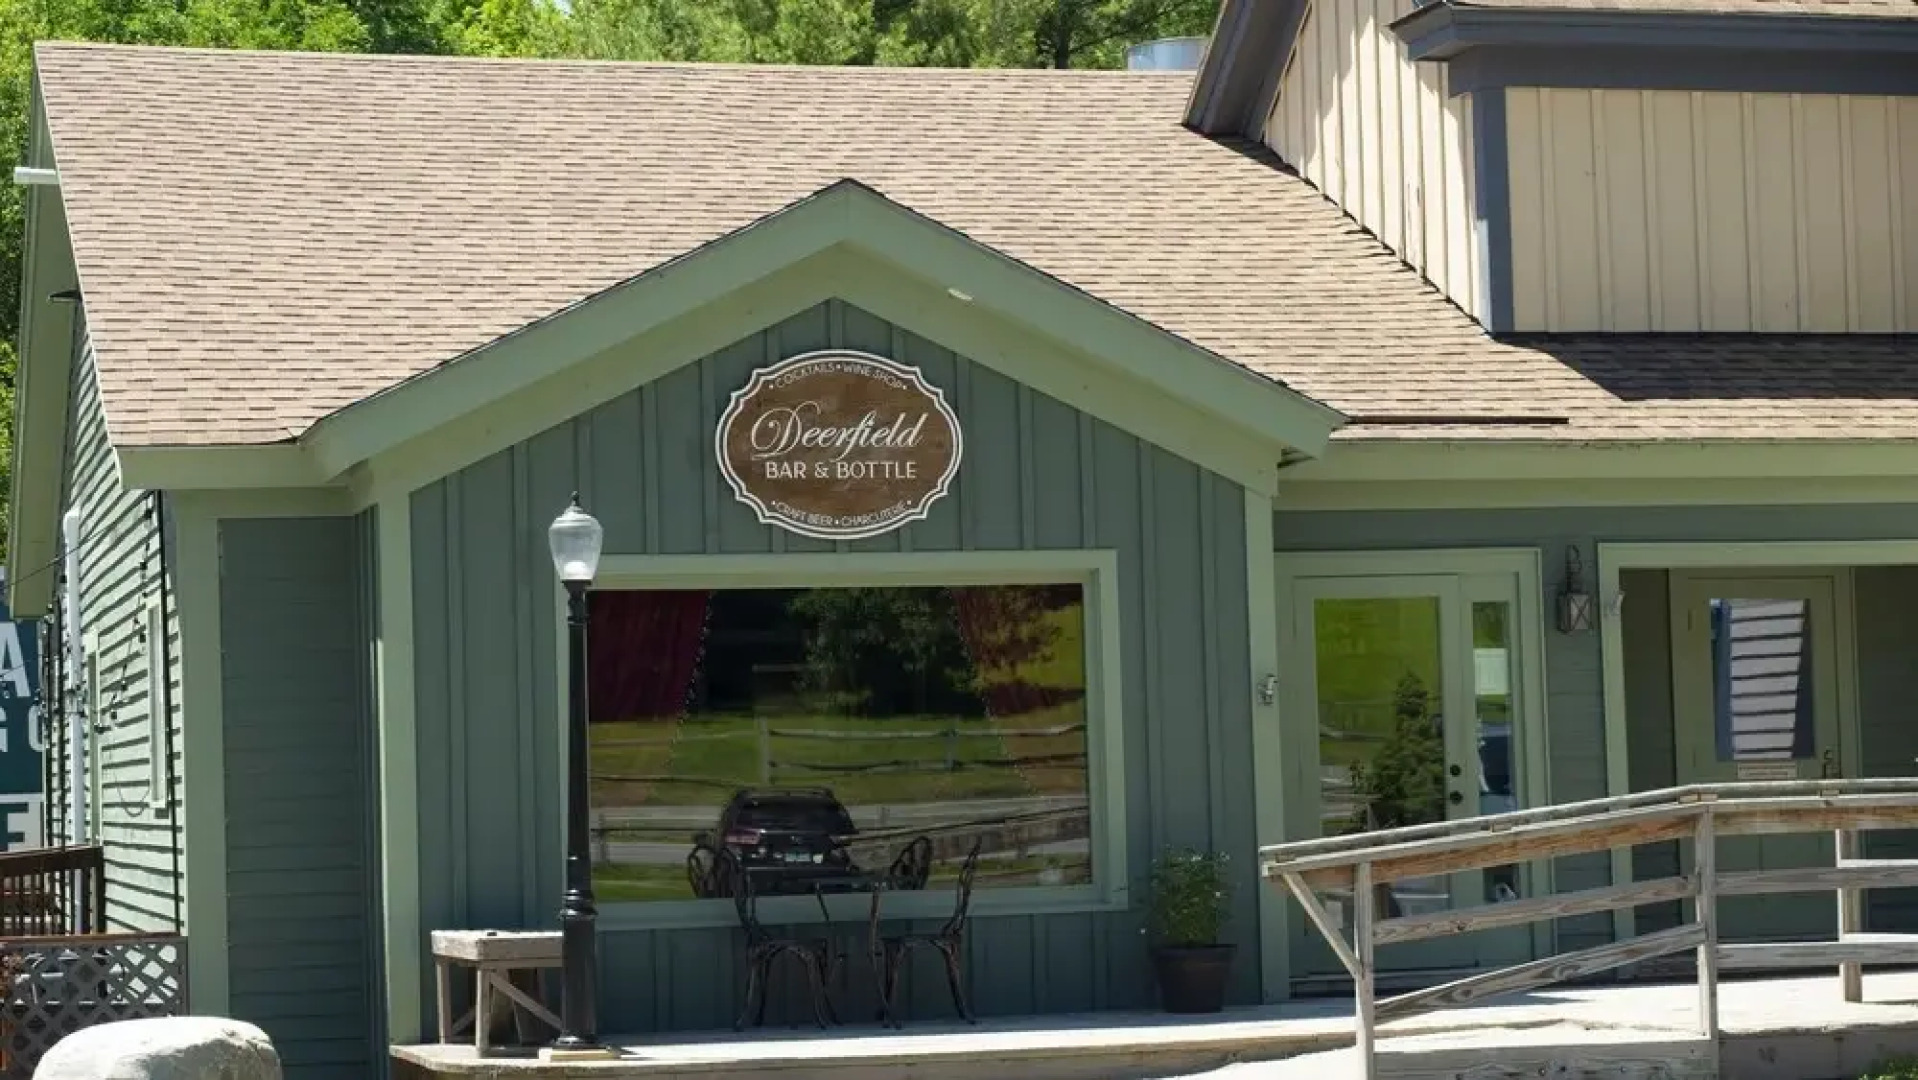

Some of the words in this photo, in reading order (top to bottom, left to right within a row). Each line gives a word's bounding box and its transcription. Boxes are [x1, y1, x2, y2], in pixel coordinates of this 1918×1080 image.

[775, 362, 835, 388] COCKTAILS
[842, 361, 871, 377] WINE
[872, 369, 903, 388] SHOP
[751, 400, 929, 463] Deerfield
[765, 461, 807, 479] BAR
[814, 461, 830, 479] &
[837, 461, 918, 479] BOTTLE
[775, 501, 807, 521] CRAFT
[807, 512, 834, 526] BEER
[841, 499, 906, 527] CHARCUTERIE
